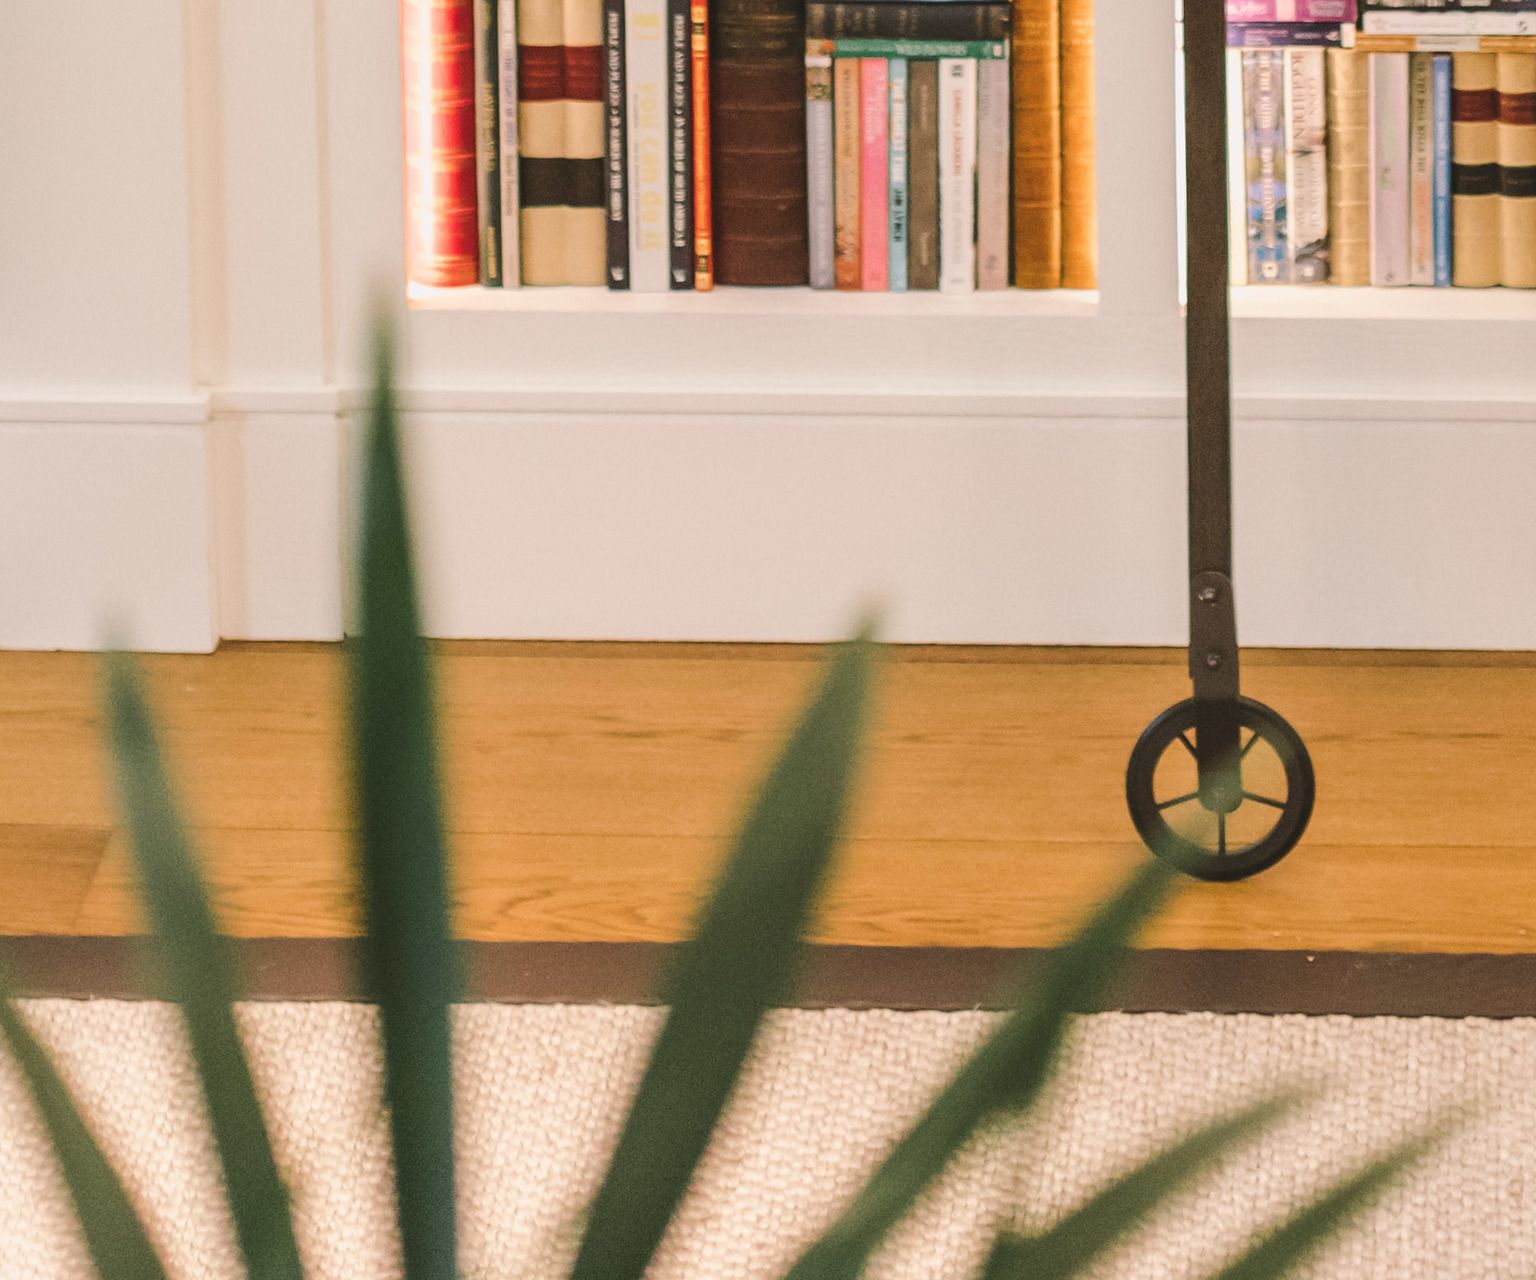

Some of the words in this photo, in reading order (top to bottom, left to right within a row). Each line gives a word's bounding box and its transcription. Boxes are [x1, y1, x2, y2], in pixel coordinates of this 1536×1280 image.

[641, 82, 660, 129] you
[642, 137, 662, 183] can
[642, 190, 664, 222] do
